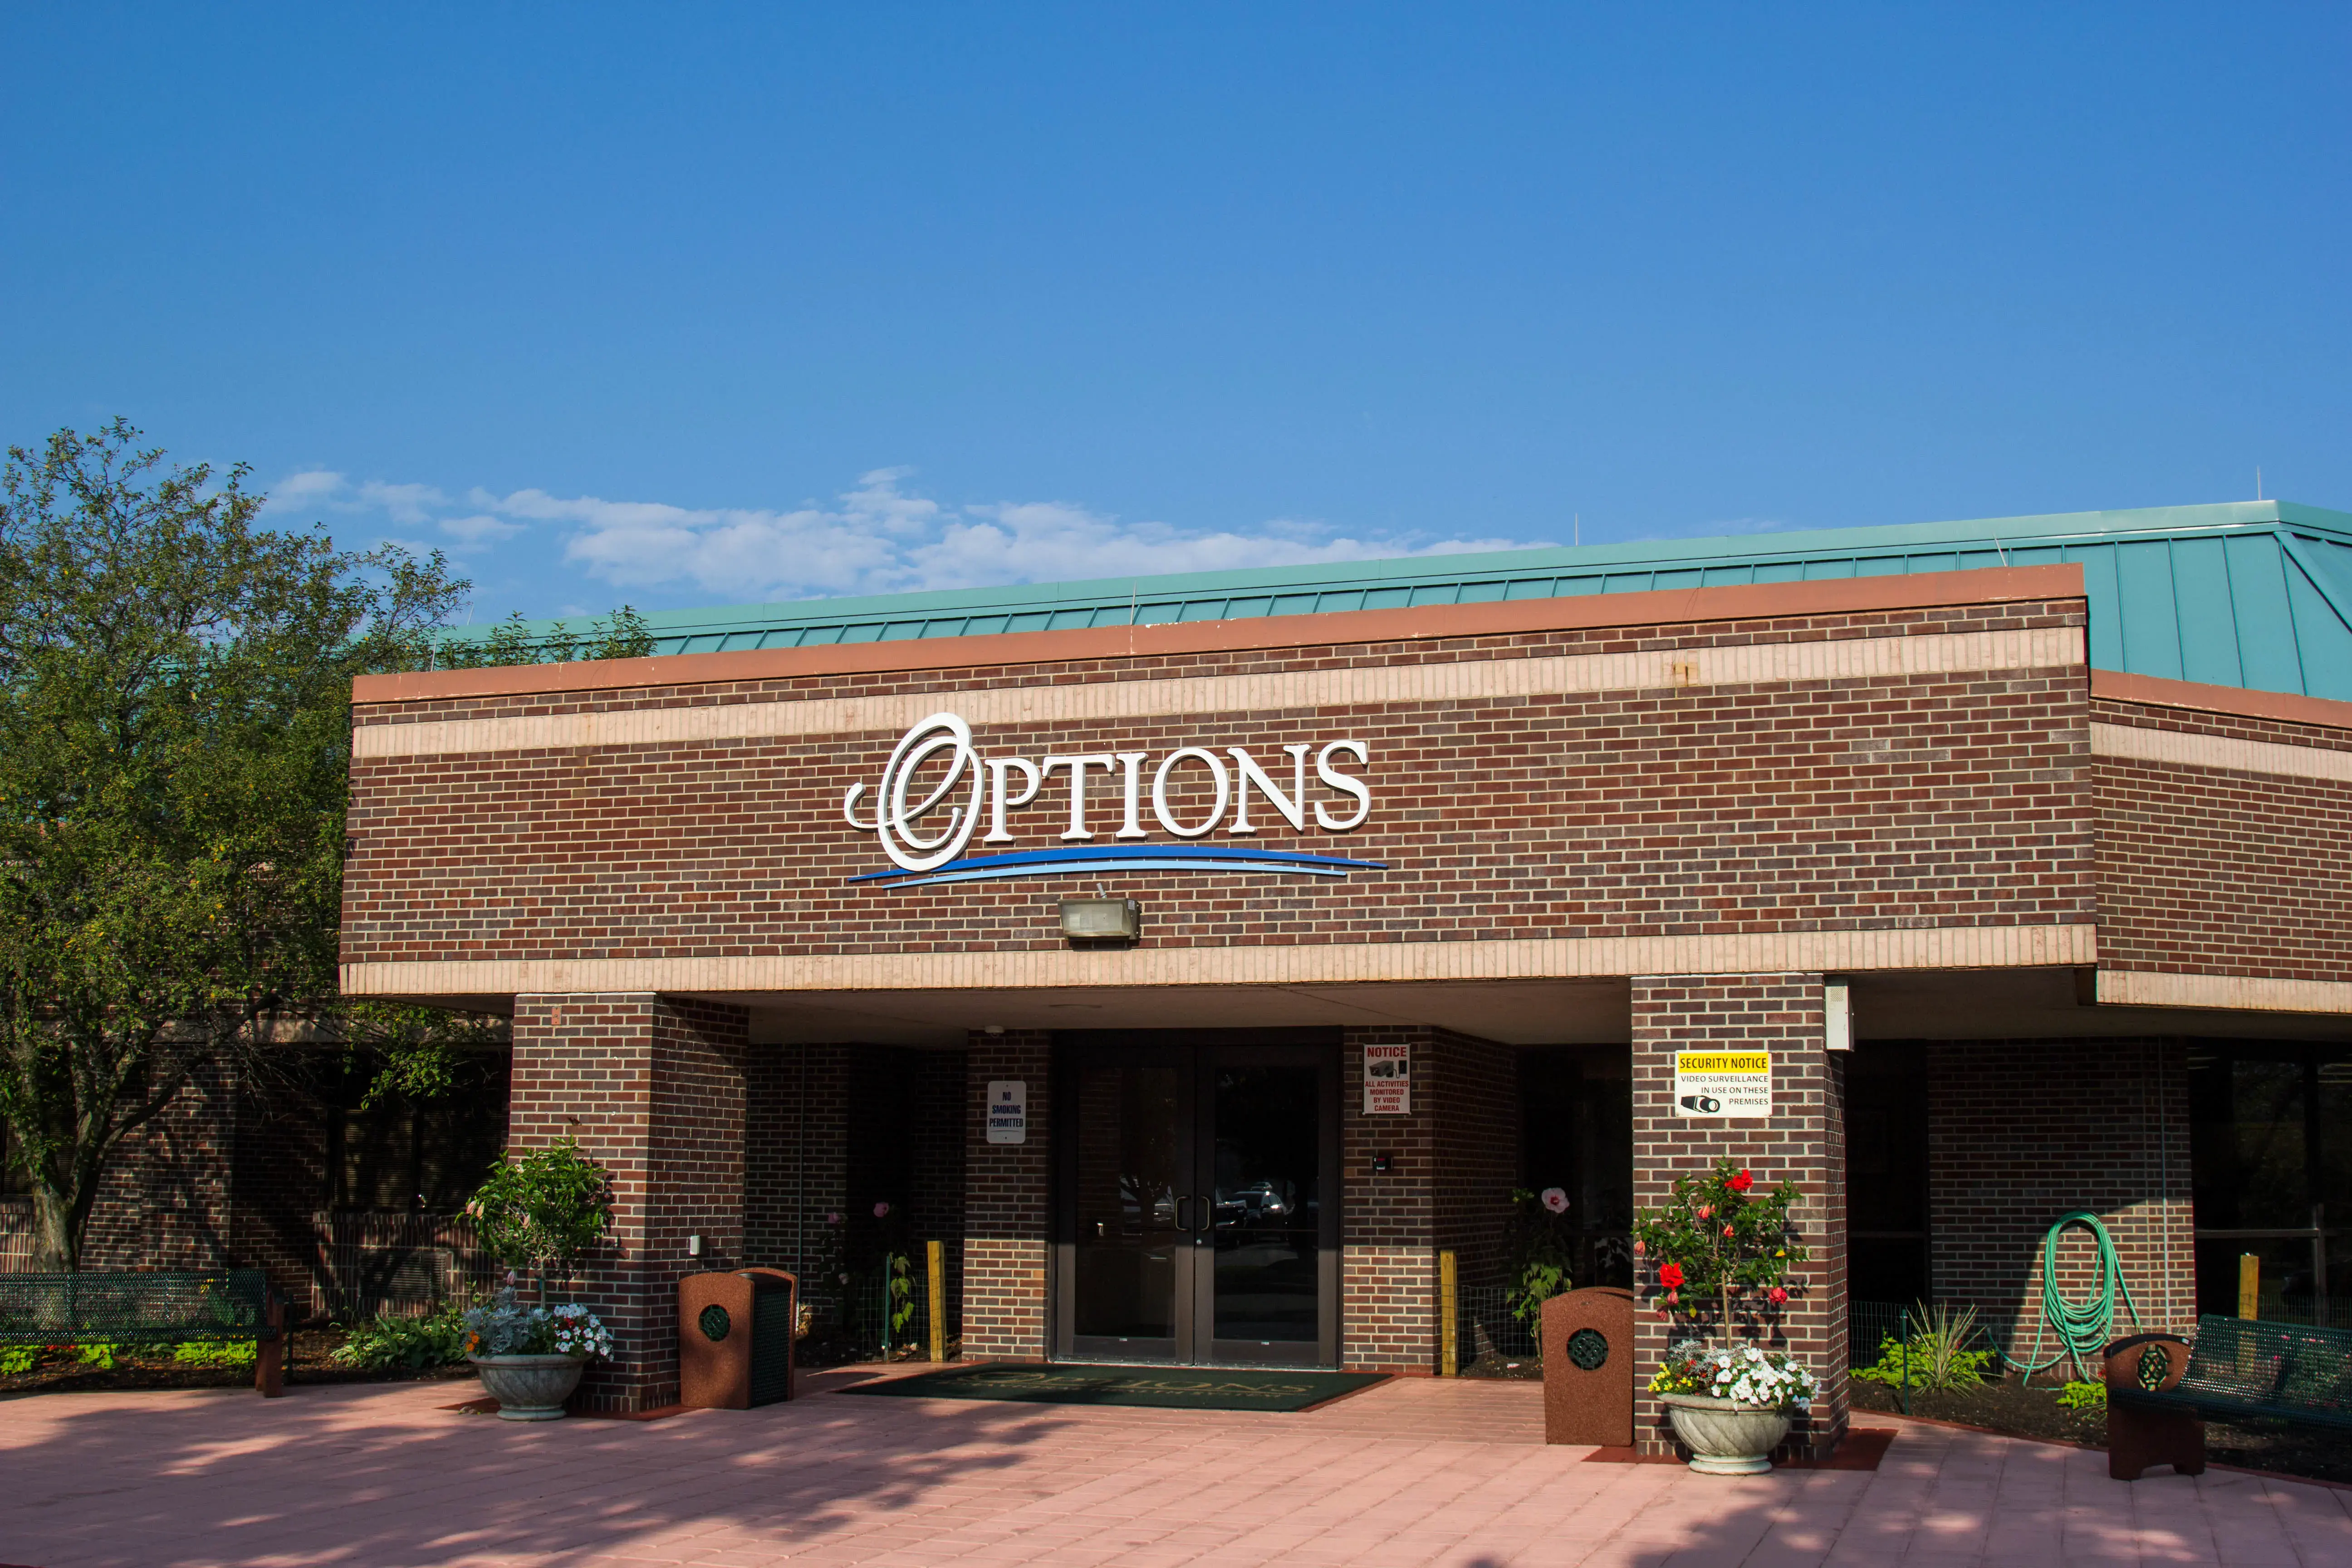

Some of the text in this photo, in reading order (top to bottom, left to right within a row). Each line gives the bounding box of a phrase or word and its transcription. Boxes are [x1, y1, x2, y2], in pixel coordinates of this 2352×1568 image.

[845, 712, 1371, 872] OPTIONS
[1367, 1047, 1406, 1058] NOTICE
[1680, 1058, 1767, 1068] SECURITY NOTICE
[1002, 1092, 1011, 1101] NO
[992, 1105, 1021, 1114] SMOKING
[989, 1118, 1023, 1127] PERMITTED
